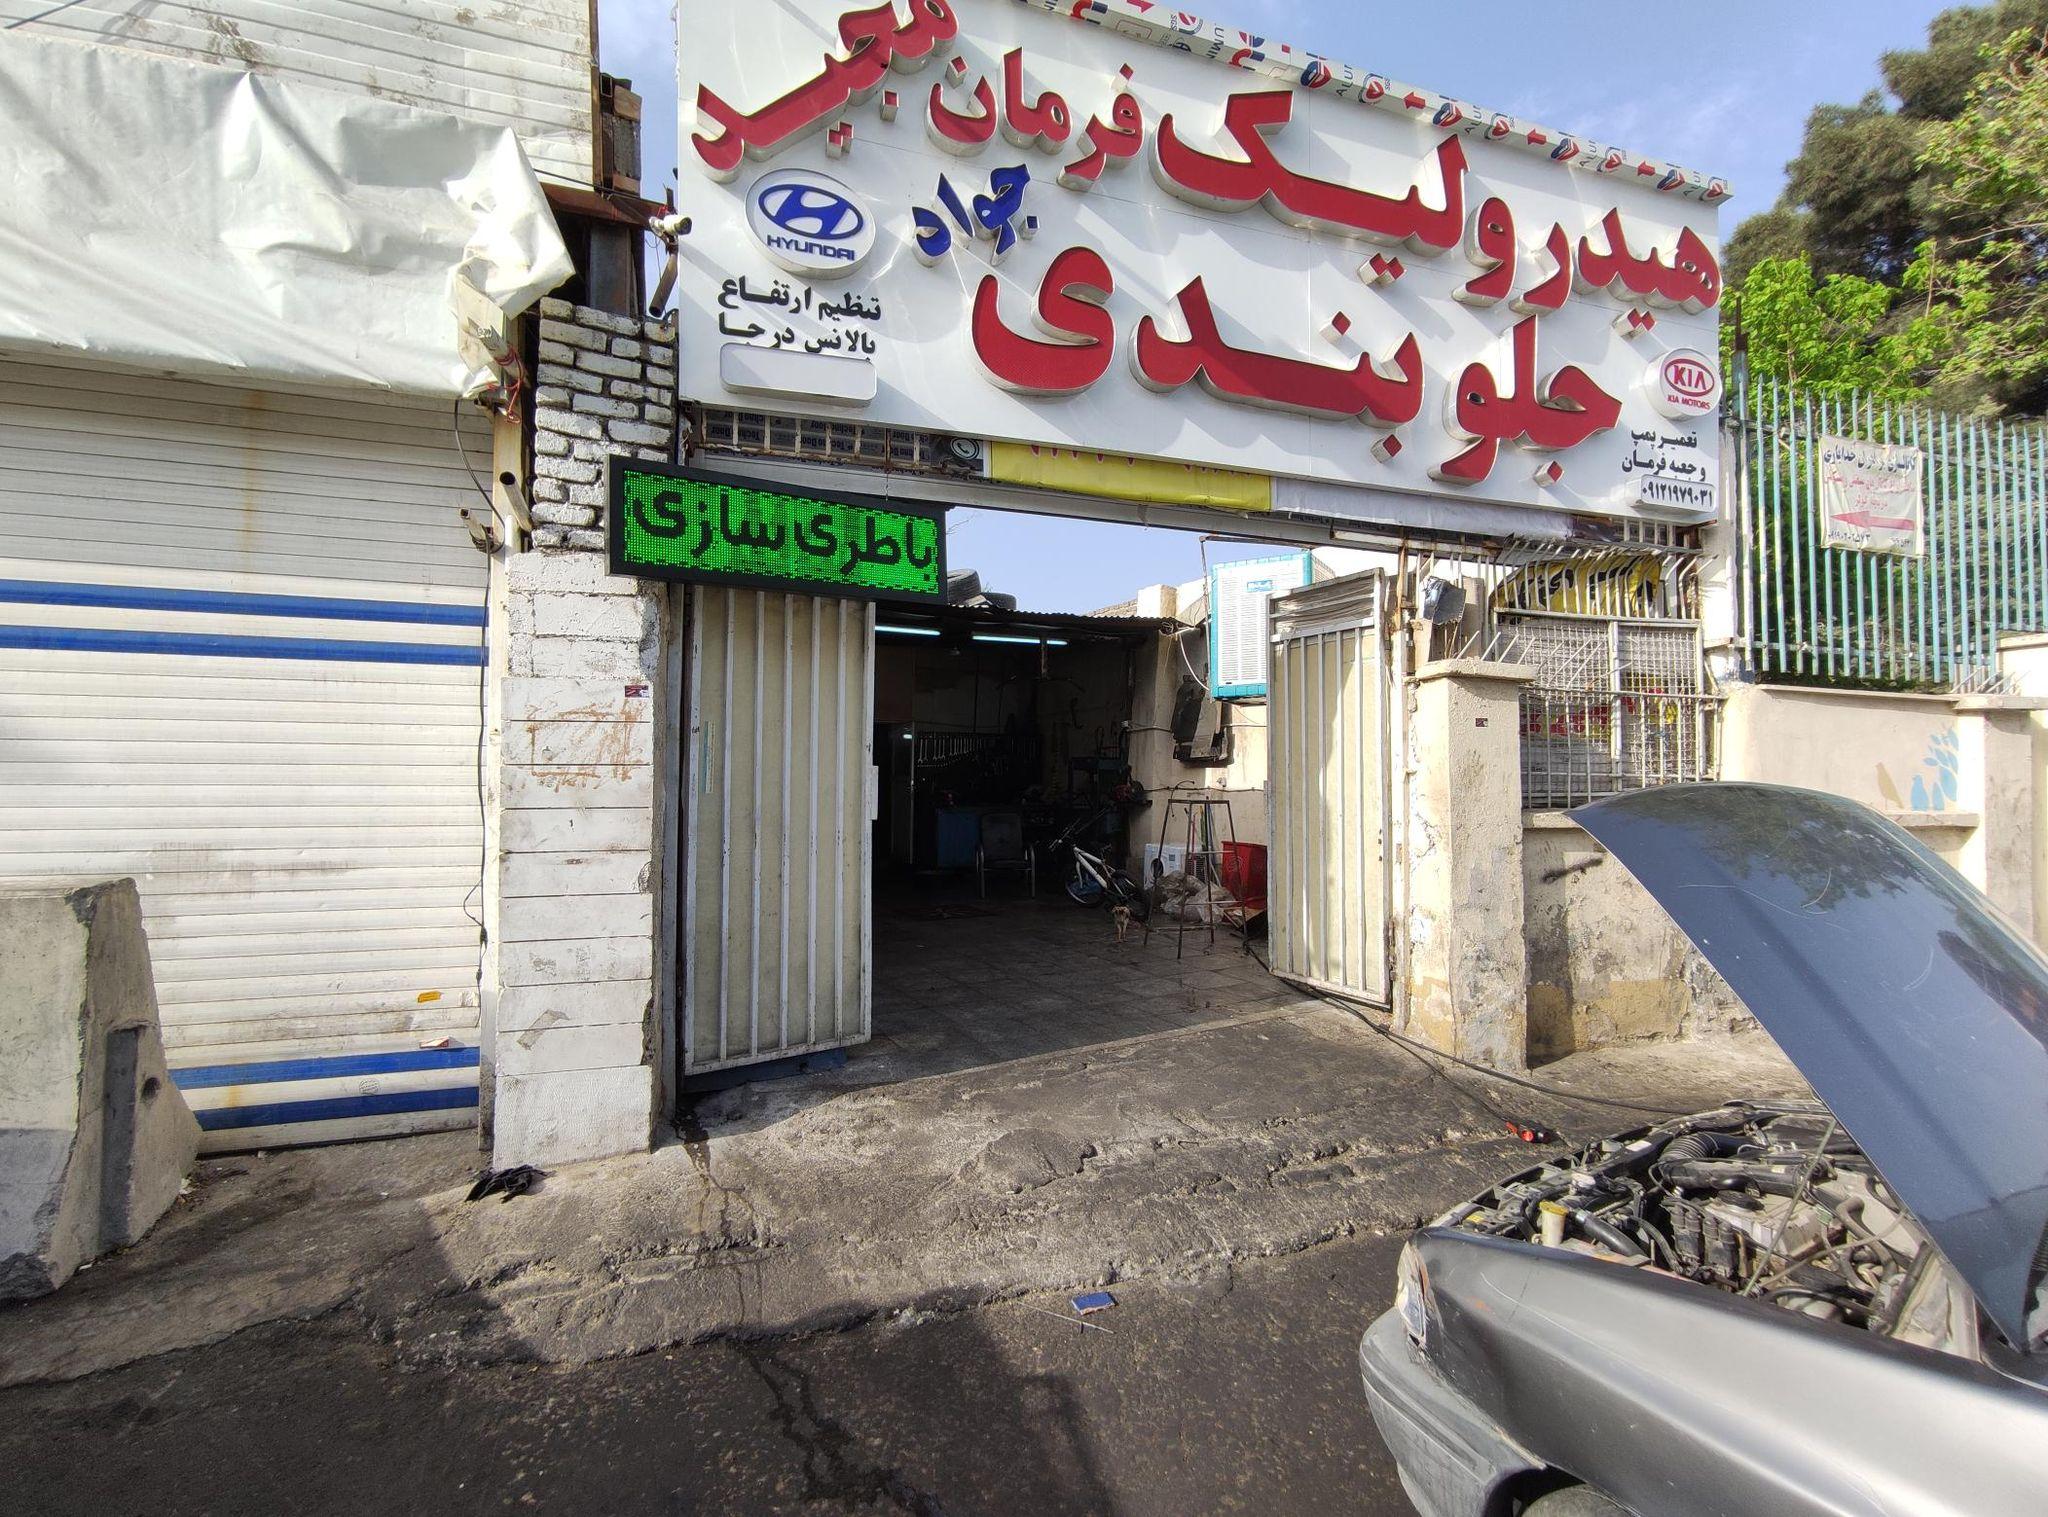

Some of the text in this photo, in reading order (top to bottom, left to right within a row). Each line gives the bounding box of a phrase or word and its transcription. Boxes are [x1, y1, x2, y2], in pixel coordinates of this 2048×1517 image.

[691, 0, 1722, 337] هیدرولیک فرمان مجید
[912, 164, 1038, 258] جواد
[766, 234, 856, 261] HYUNDAI
[717, 275, 882, 322] تنظیم ارتفاع
[804, 328, 877, 362] بالانس
[1673, 364, 1707, 391] KIA
[1667, 394, 1711, 411] KIA MOTORS
[1630, 429, 1698, 450] تعمیر پمپ
[1621, 449, 1667, 476] فرمان
[1699, 466, 1706, 482] و
[1642, 480, 1713, 510] ۰۹۱۲۱۹۷۹۰۳۱
[632, 485, 932, 582] باطری سازی
